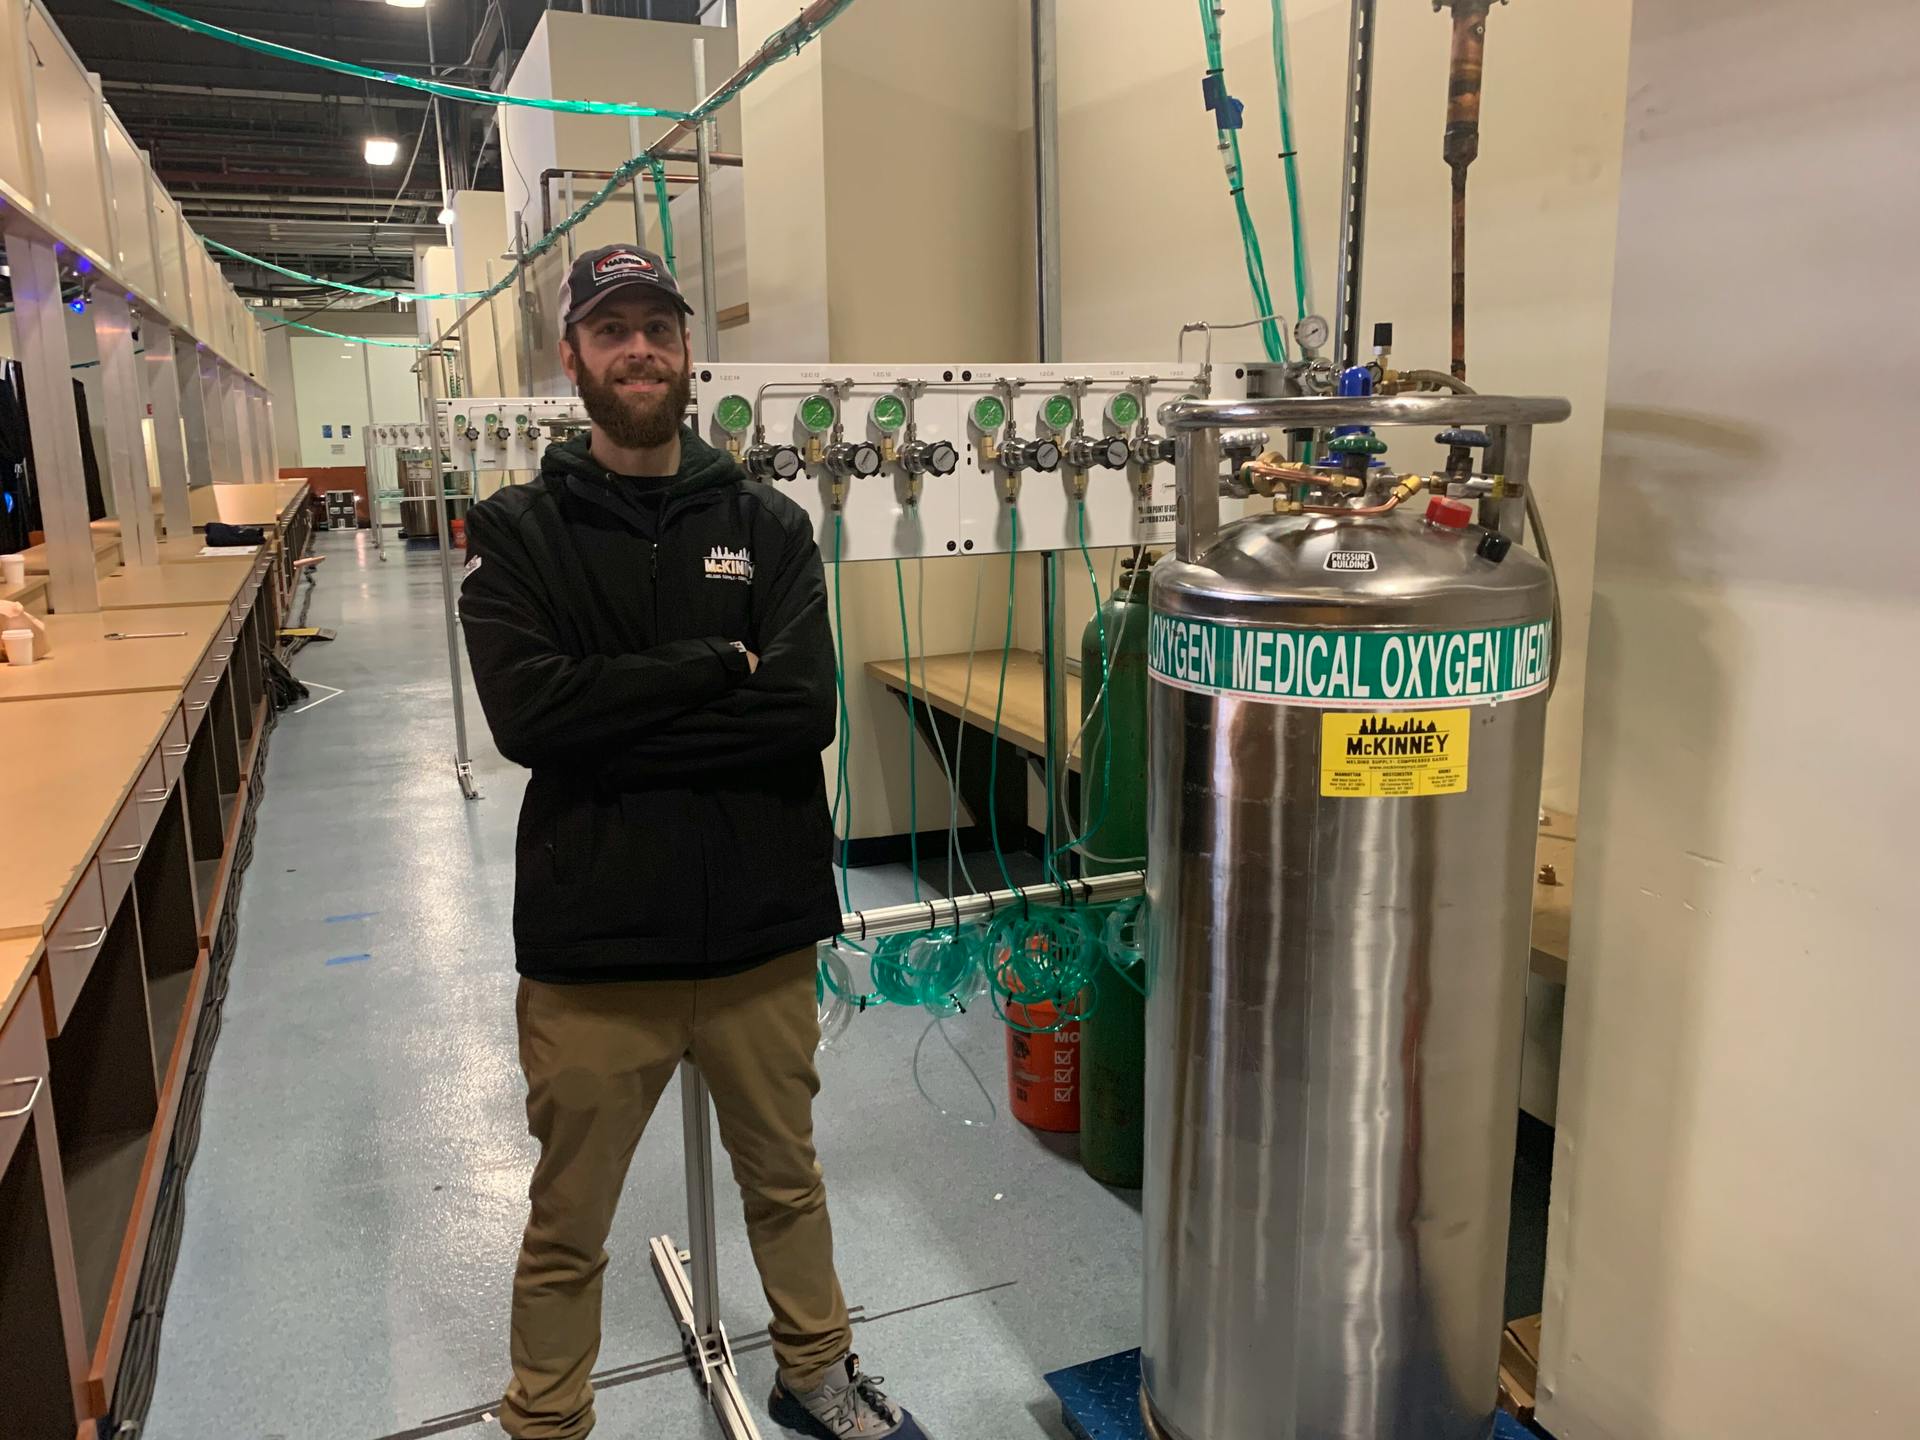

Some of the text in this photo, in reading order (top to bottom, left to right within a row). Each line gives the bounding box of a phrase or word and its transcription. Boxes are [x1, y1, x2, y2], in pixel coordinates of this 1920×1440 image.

[1331, 553, 1370, 561] PRESSURE
[1331, 560, 1369, 569] BUILDING
[1152, 615, 1217, 685] OXYGEN
[1232, 629, 1370, 697] MEDICAL
[1380, 630, 1501, 698] OXYGEN
[1346, 733, 1450, 756] McKINNEY
